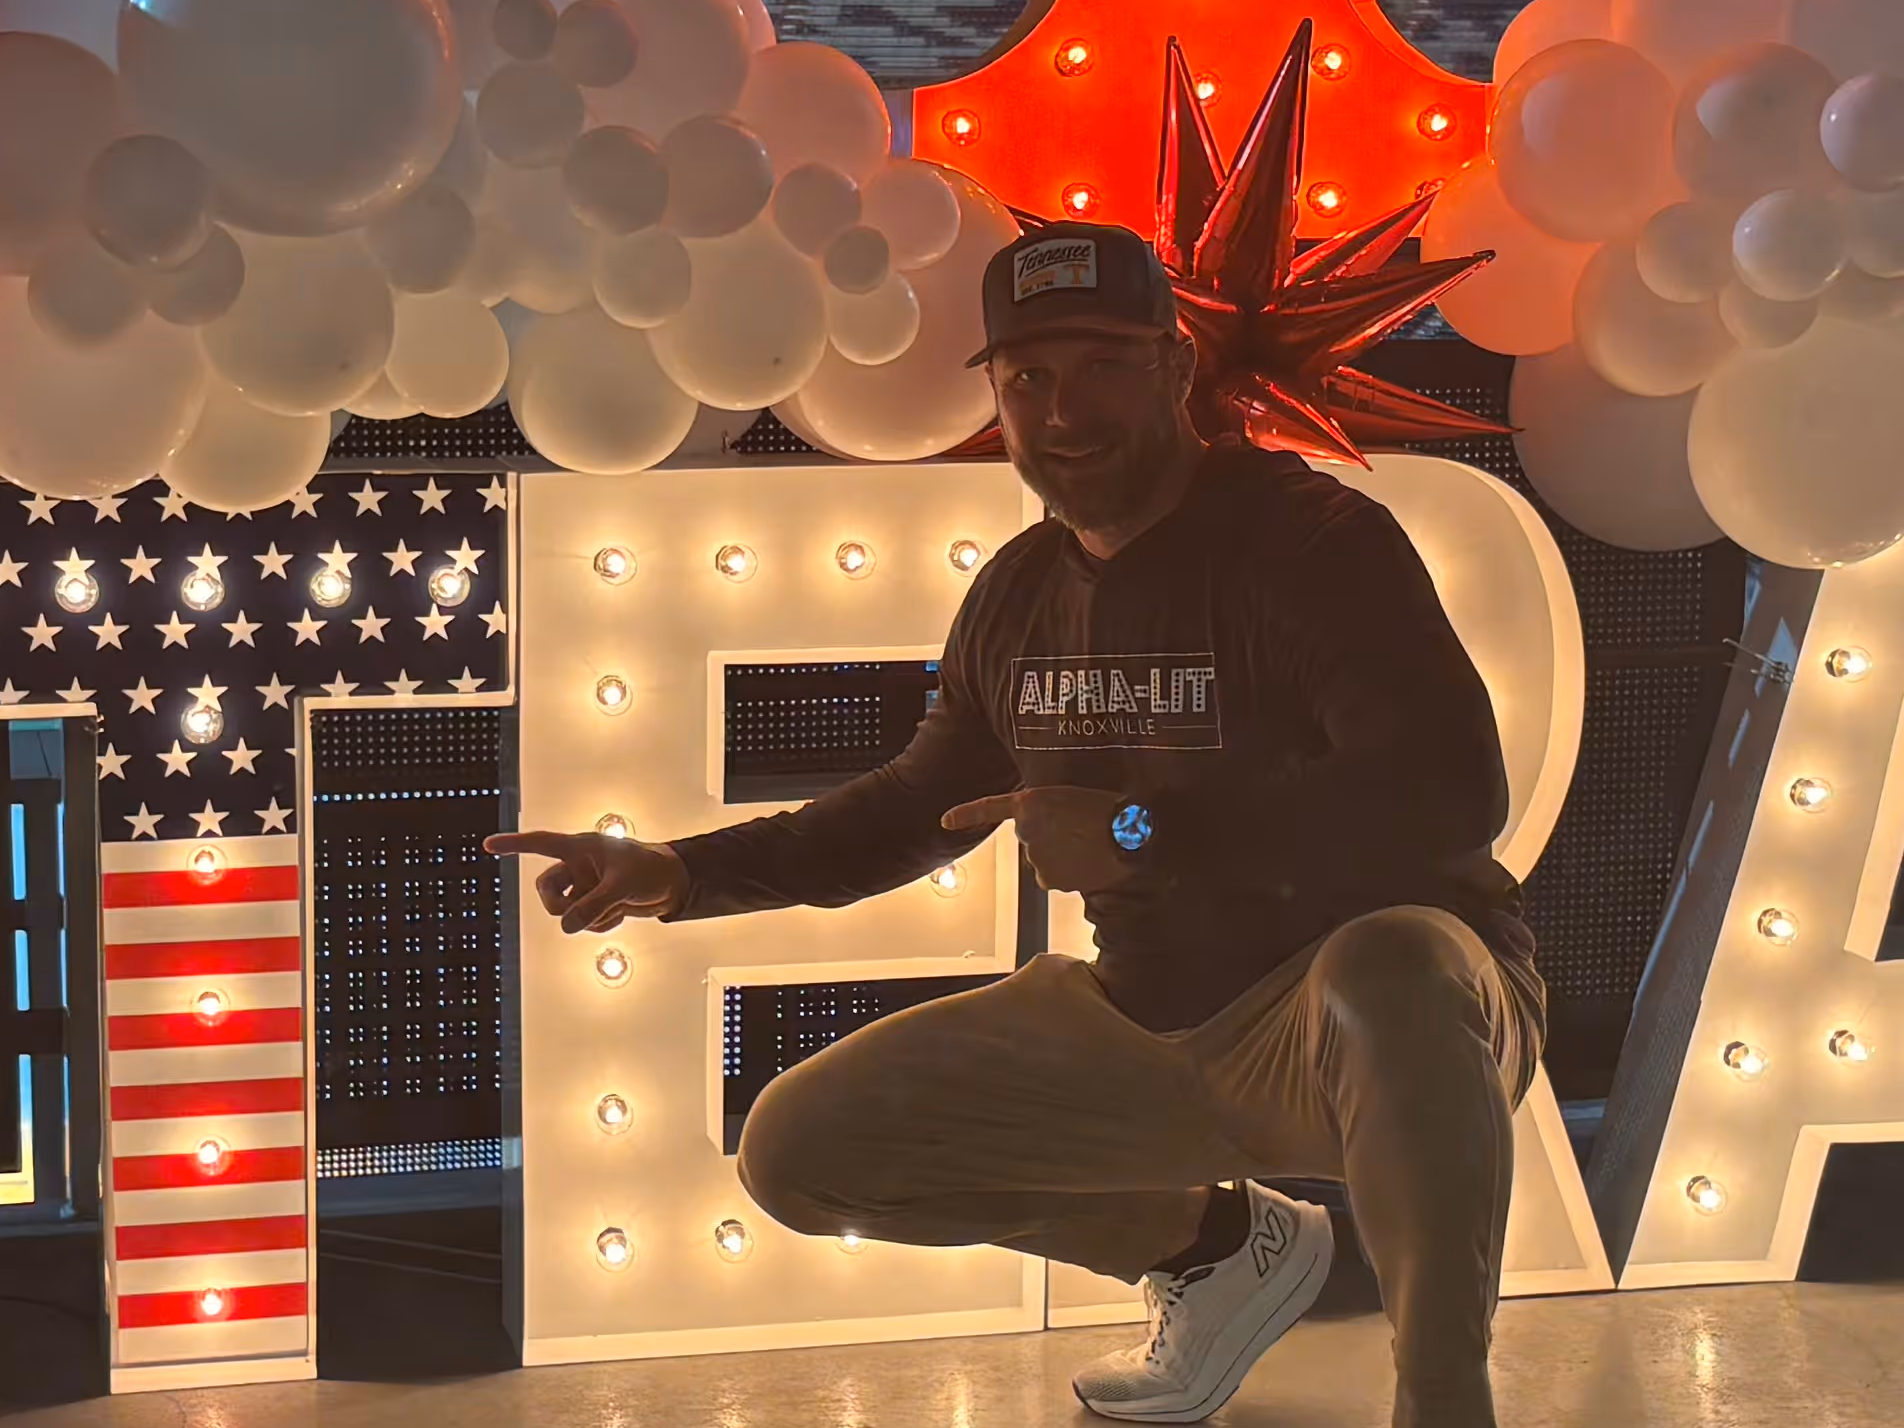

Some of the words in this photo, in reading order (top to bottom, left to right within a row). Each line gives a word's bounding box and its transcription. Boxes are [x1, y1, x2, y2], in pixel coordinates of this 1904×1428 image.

[1017, 245, 1092, 279] Tennessee
[1018, 667, 1215, 715] ALPHA-LIT
[1057, 719, 1157, 736] KNOXVILLE
